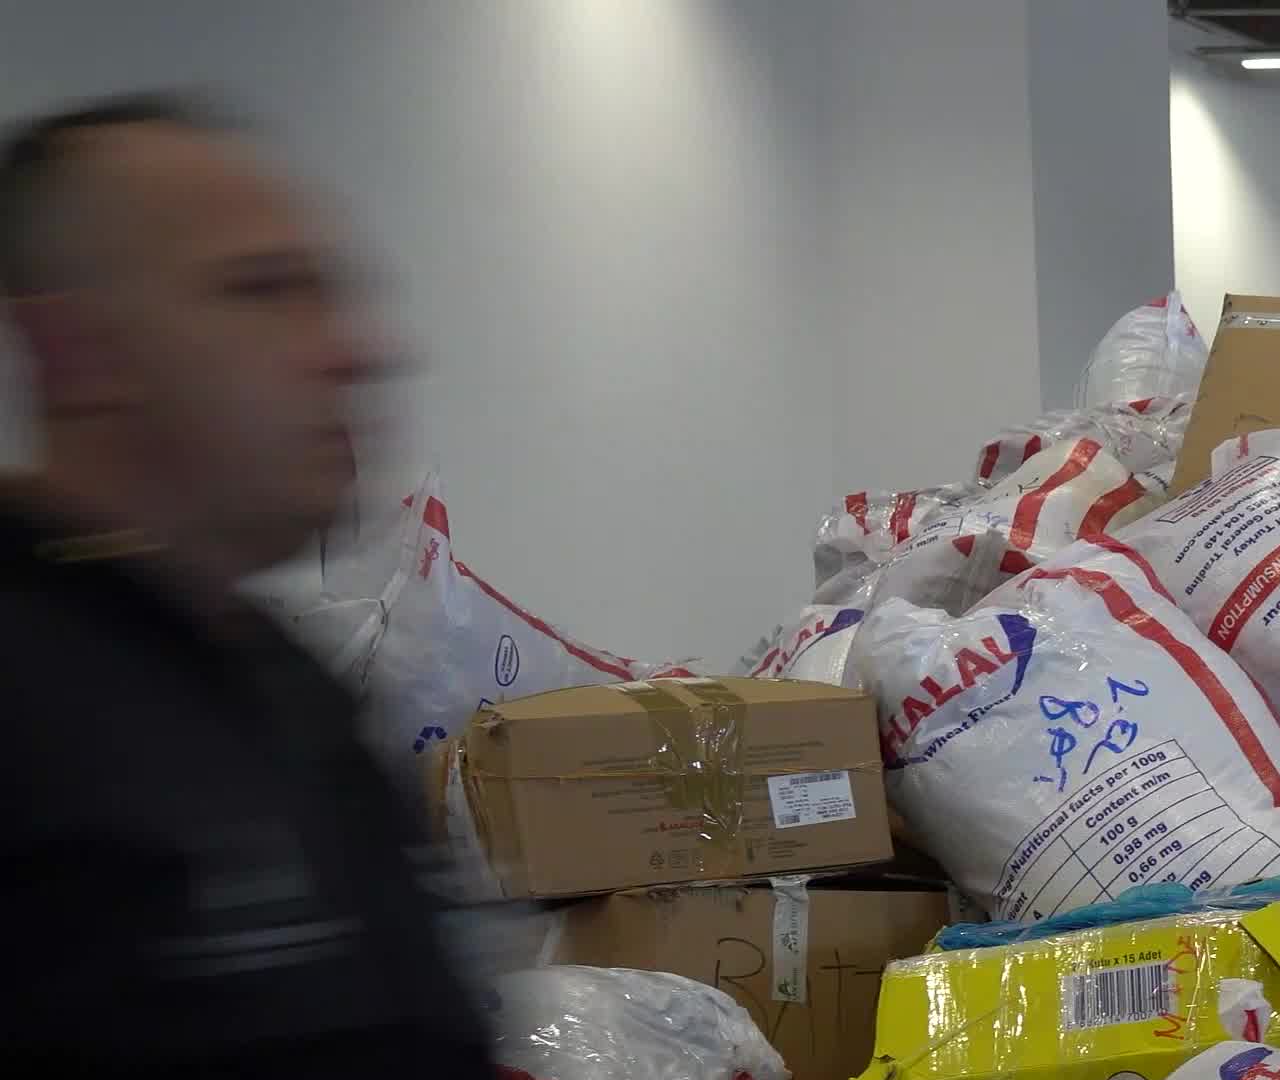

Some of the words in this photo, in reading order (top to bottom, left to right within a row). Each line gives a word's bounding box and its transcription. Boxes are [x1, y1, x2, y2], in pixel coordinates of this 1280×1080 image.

[1232, 525, 1275, 557] Turkey
[1184, 552, 1223, 597] Trading
[924, 721, 971, 760] Wheat
[968, 693, 1012, 723] Flour
[1009, 811, 1069, 873] Nutritional
[1069, 783, 1104, 813] facts
[1106, 768, 1129, 788] per
[1131, 750, 1167, 770] 100g
[1085, 787, 1140, 829] Content
[1141, 771, 1171, 791] m/m
[1100, 824, 1125, 847] 100
[1113, 838, 1143, 865] 0,98
[1144, 821, 1168, 841] mg
[1128, 856, 1158, 883] 0,66
[1159, 838, 1183, 859] mg
[1138, 950, 1162, 962] Adet
